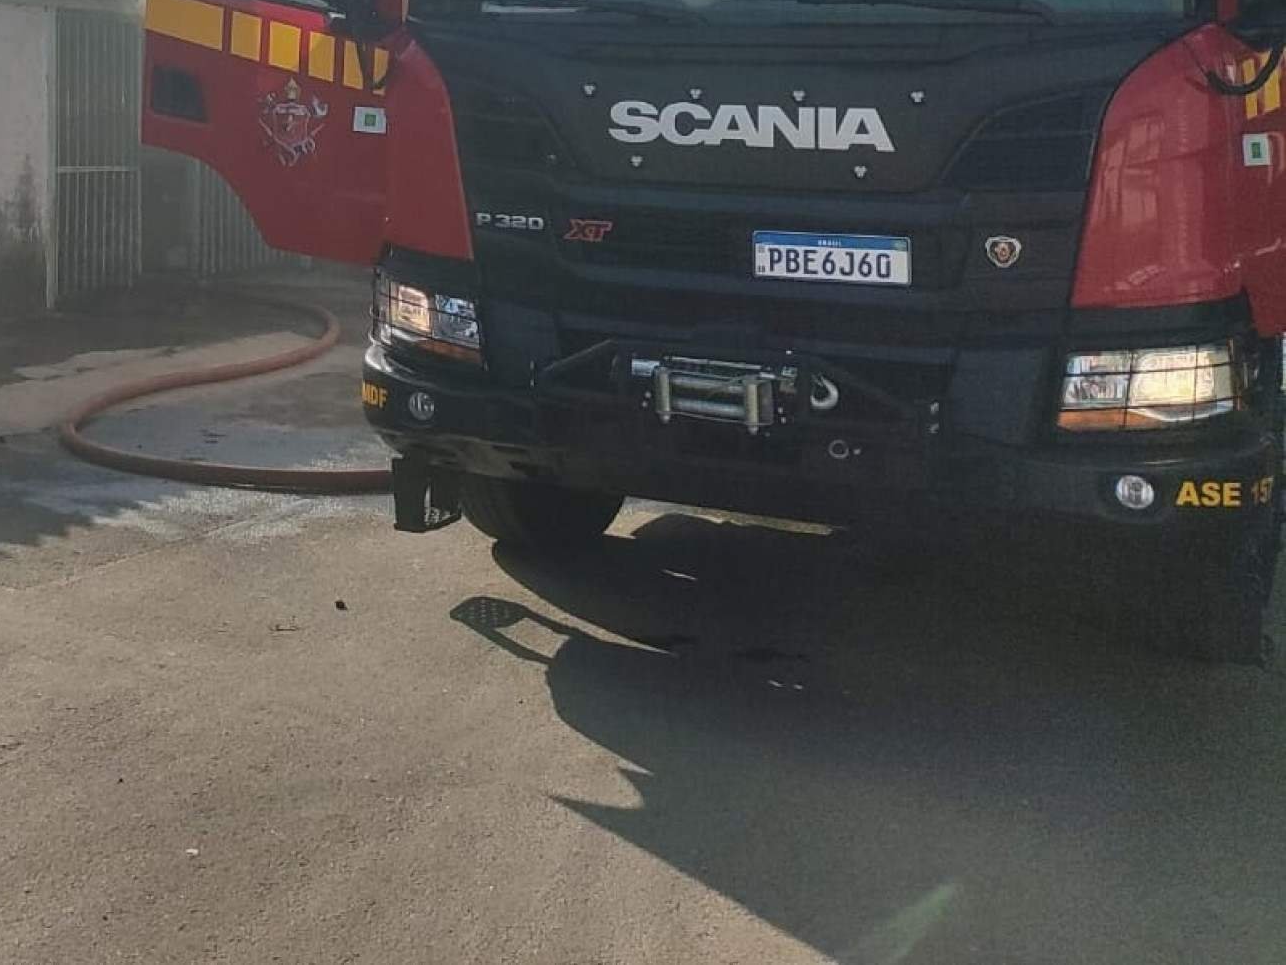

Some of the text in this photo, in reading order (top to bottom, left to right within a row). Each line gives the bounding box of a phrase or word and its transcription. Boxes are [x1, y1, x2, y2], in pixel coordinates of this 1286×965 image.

[608, 100, 896, 153] SCANIA
[474, 212, 544, 230] P 320
[563, 218, 612, 241] XT
[767, 247, 891, 279] PBE6J60
[1175, 481, 1241, 506] ASE
